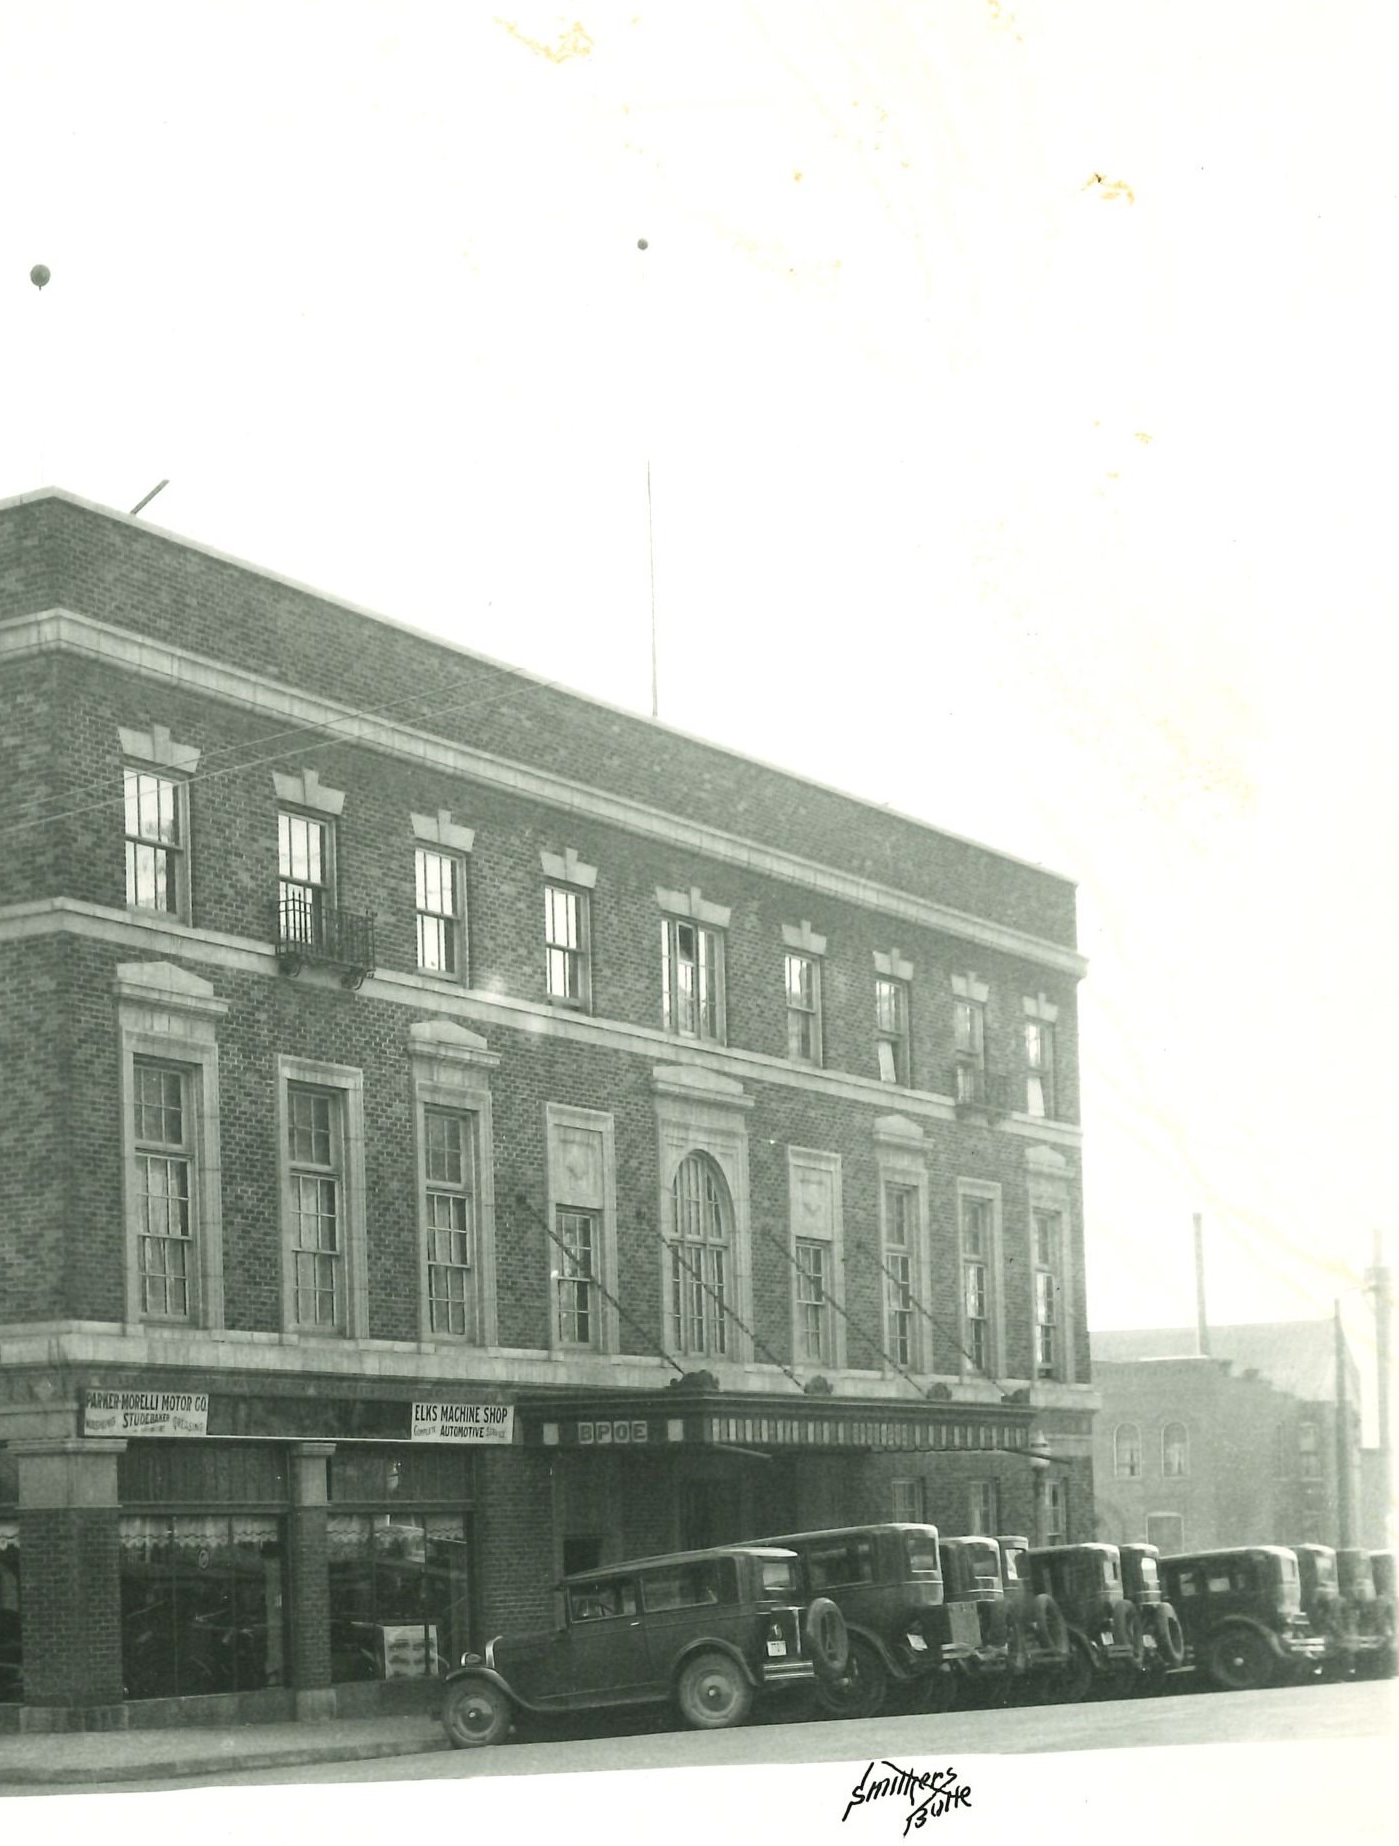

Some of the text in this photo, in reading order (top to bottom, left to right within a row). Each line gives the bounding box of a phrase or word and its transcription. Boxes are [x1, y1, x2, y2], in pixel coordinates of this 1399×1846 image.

[161, 1394, 193, 1412] MOTOR
[122, 1413, 170, 1429] STUDEBAKER
[415, 1404, 508, 1424] ELKS MACHINE SHOP
[440, 1425, 485, 1438] AUTOMOTIVE
[579, 1421, 648, 1443] BPOE
